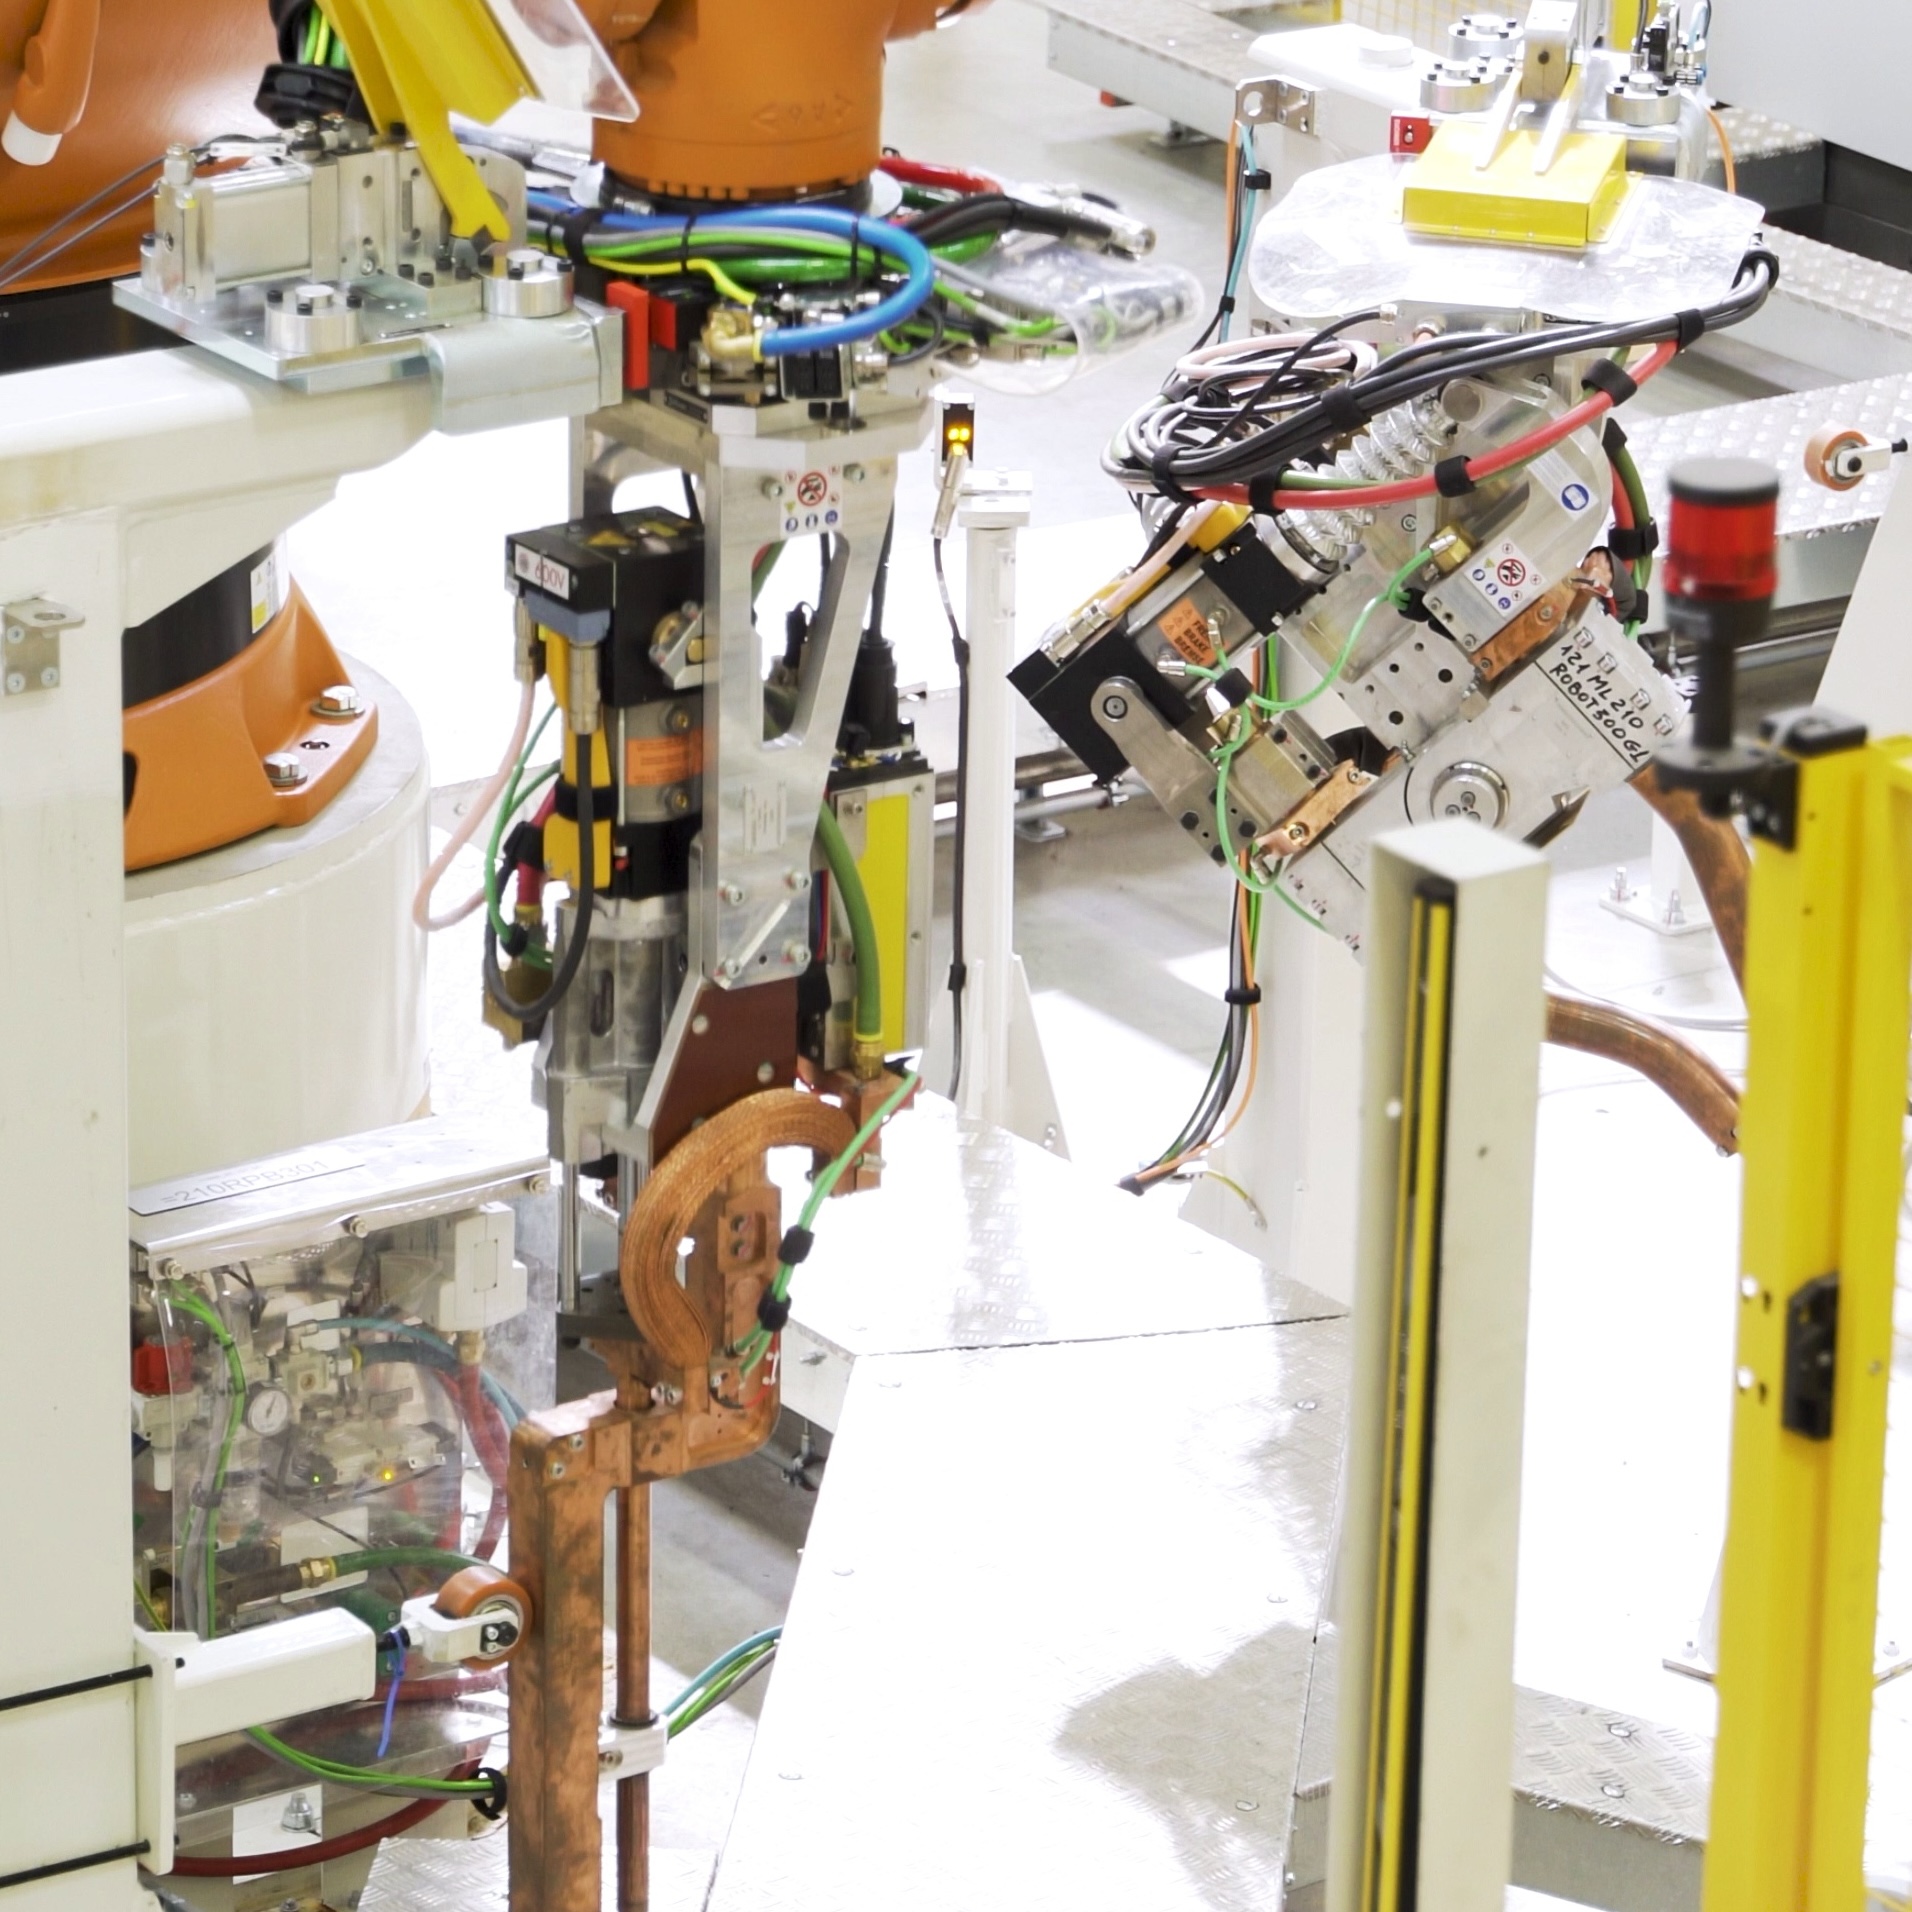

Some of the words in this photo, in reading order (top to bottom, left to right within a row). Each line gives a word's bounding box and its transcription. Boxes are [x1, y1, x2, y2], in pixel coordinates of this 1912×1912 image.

[1183, 628, 1209, 652] BRAKE
[1561, 645, 1590, 674] 121
[1587, 675, 1612, 700] ML
[1611, 699, 1644, 729] 210
